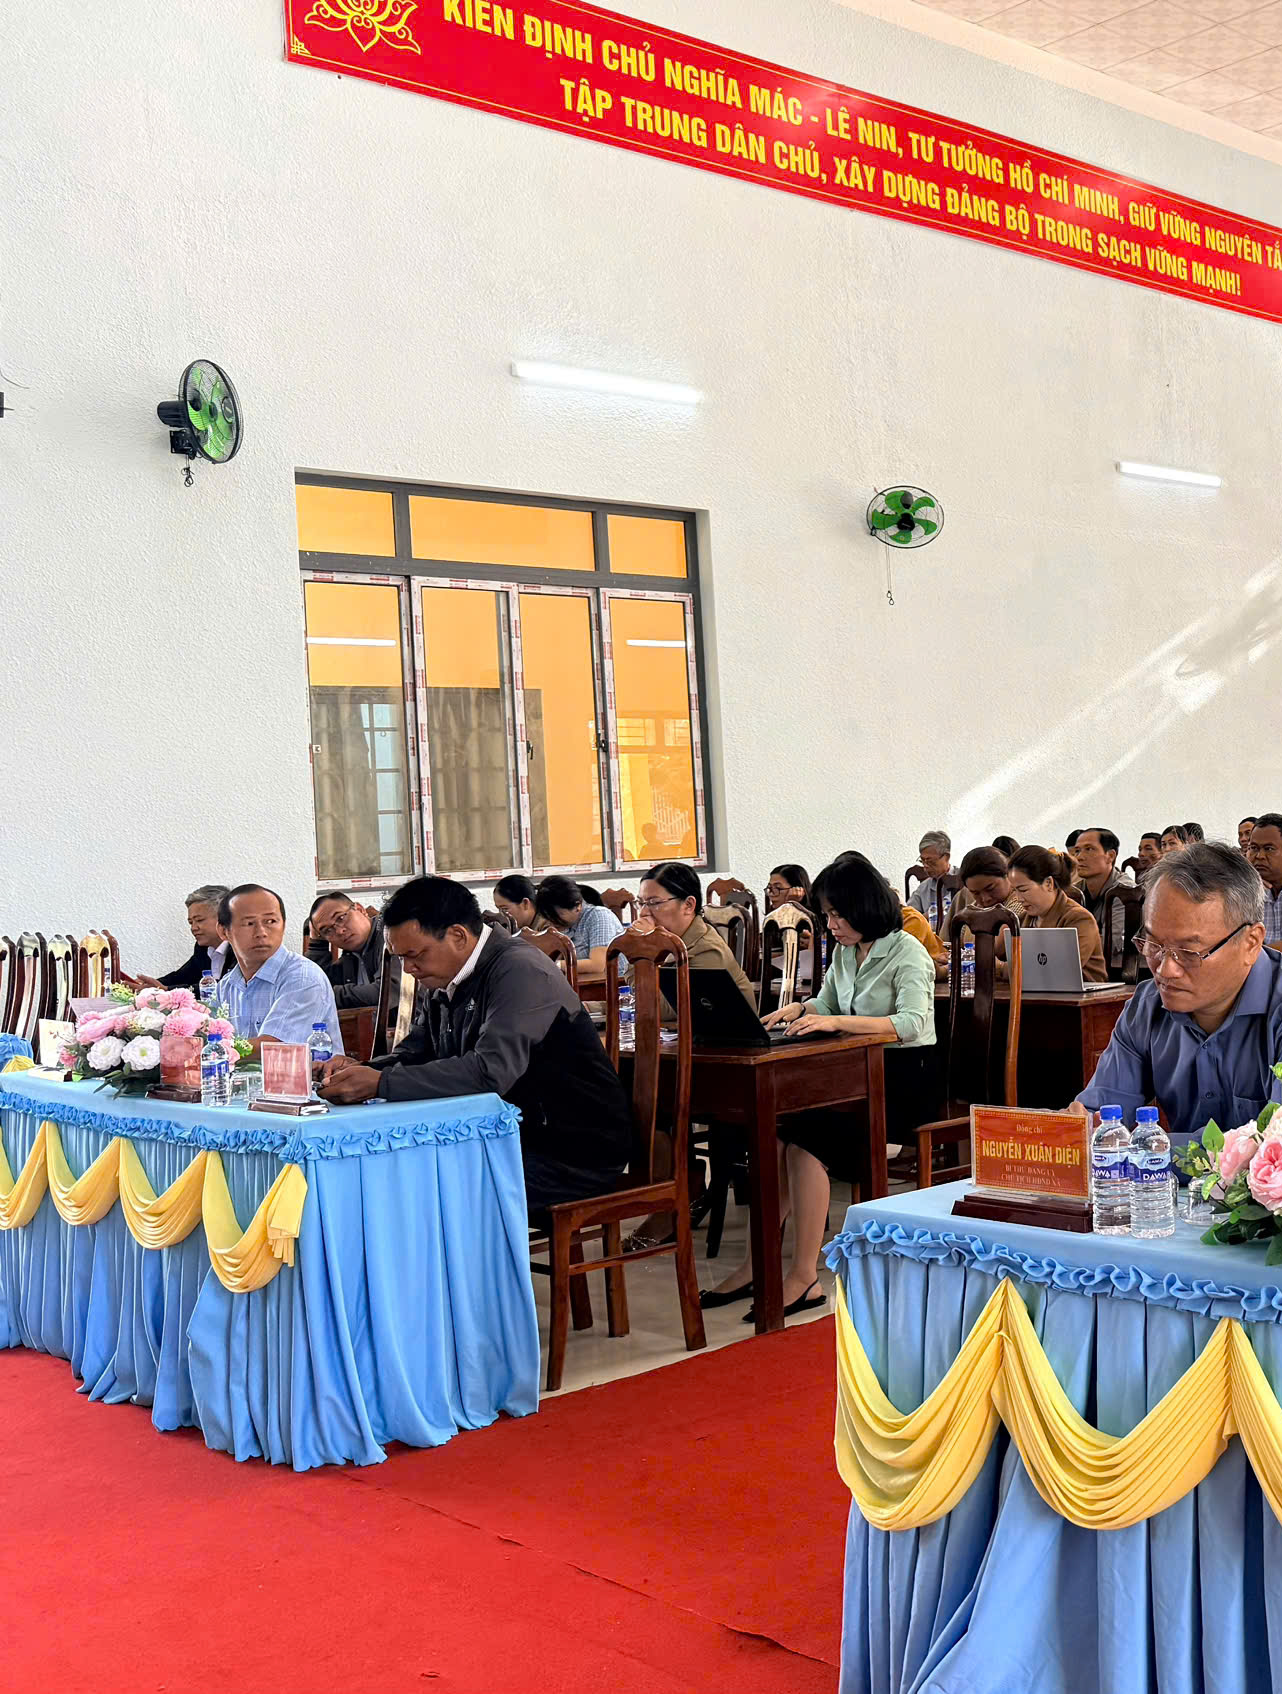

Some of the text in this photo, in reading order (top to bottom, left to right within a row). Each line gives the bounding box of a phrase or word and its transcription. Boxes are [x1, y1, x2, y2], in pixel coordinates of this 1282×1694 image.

[524, 14, 593, 64] ĐỊNH
[601, 39, 656, 81] CHỦ
[664, 57, 742, 108] NGHĨA
[750, 84, 802, 126] MÁC
[825, 106, 851, 140] LÊ
[858, 117, 903, 158] NIN,
[908, 131, 936, 163] TƯ
[939, 140, 1004, 184] TƯỞNG
[1009, 159, 1033, 193] HỒ
[1039, 172, 1069, 205] CHÍ
[1074, 184, 1124, 224] MINH,
[1129, 201, 1156, 232] GIỮ
[1159, 211, 1200, 245] VỮNG
[1204, 226, 1262, 265] NGUYÊN
[560, 77, 1241, 296] TẬP TRUNG DÂN CHỦ, XÂY DỰNG ĐẢNG BỘ TRONG SẠCH VỮNG MẠNH!
[982, 1136, 1080, 1169] NGUYỄN XUÂN DIỆN
